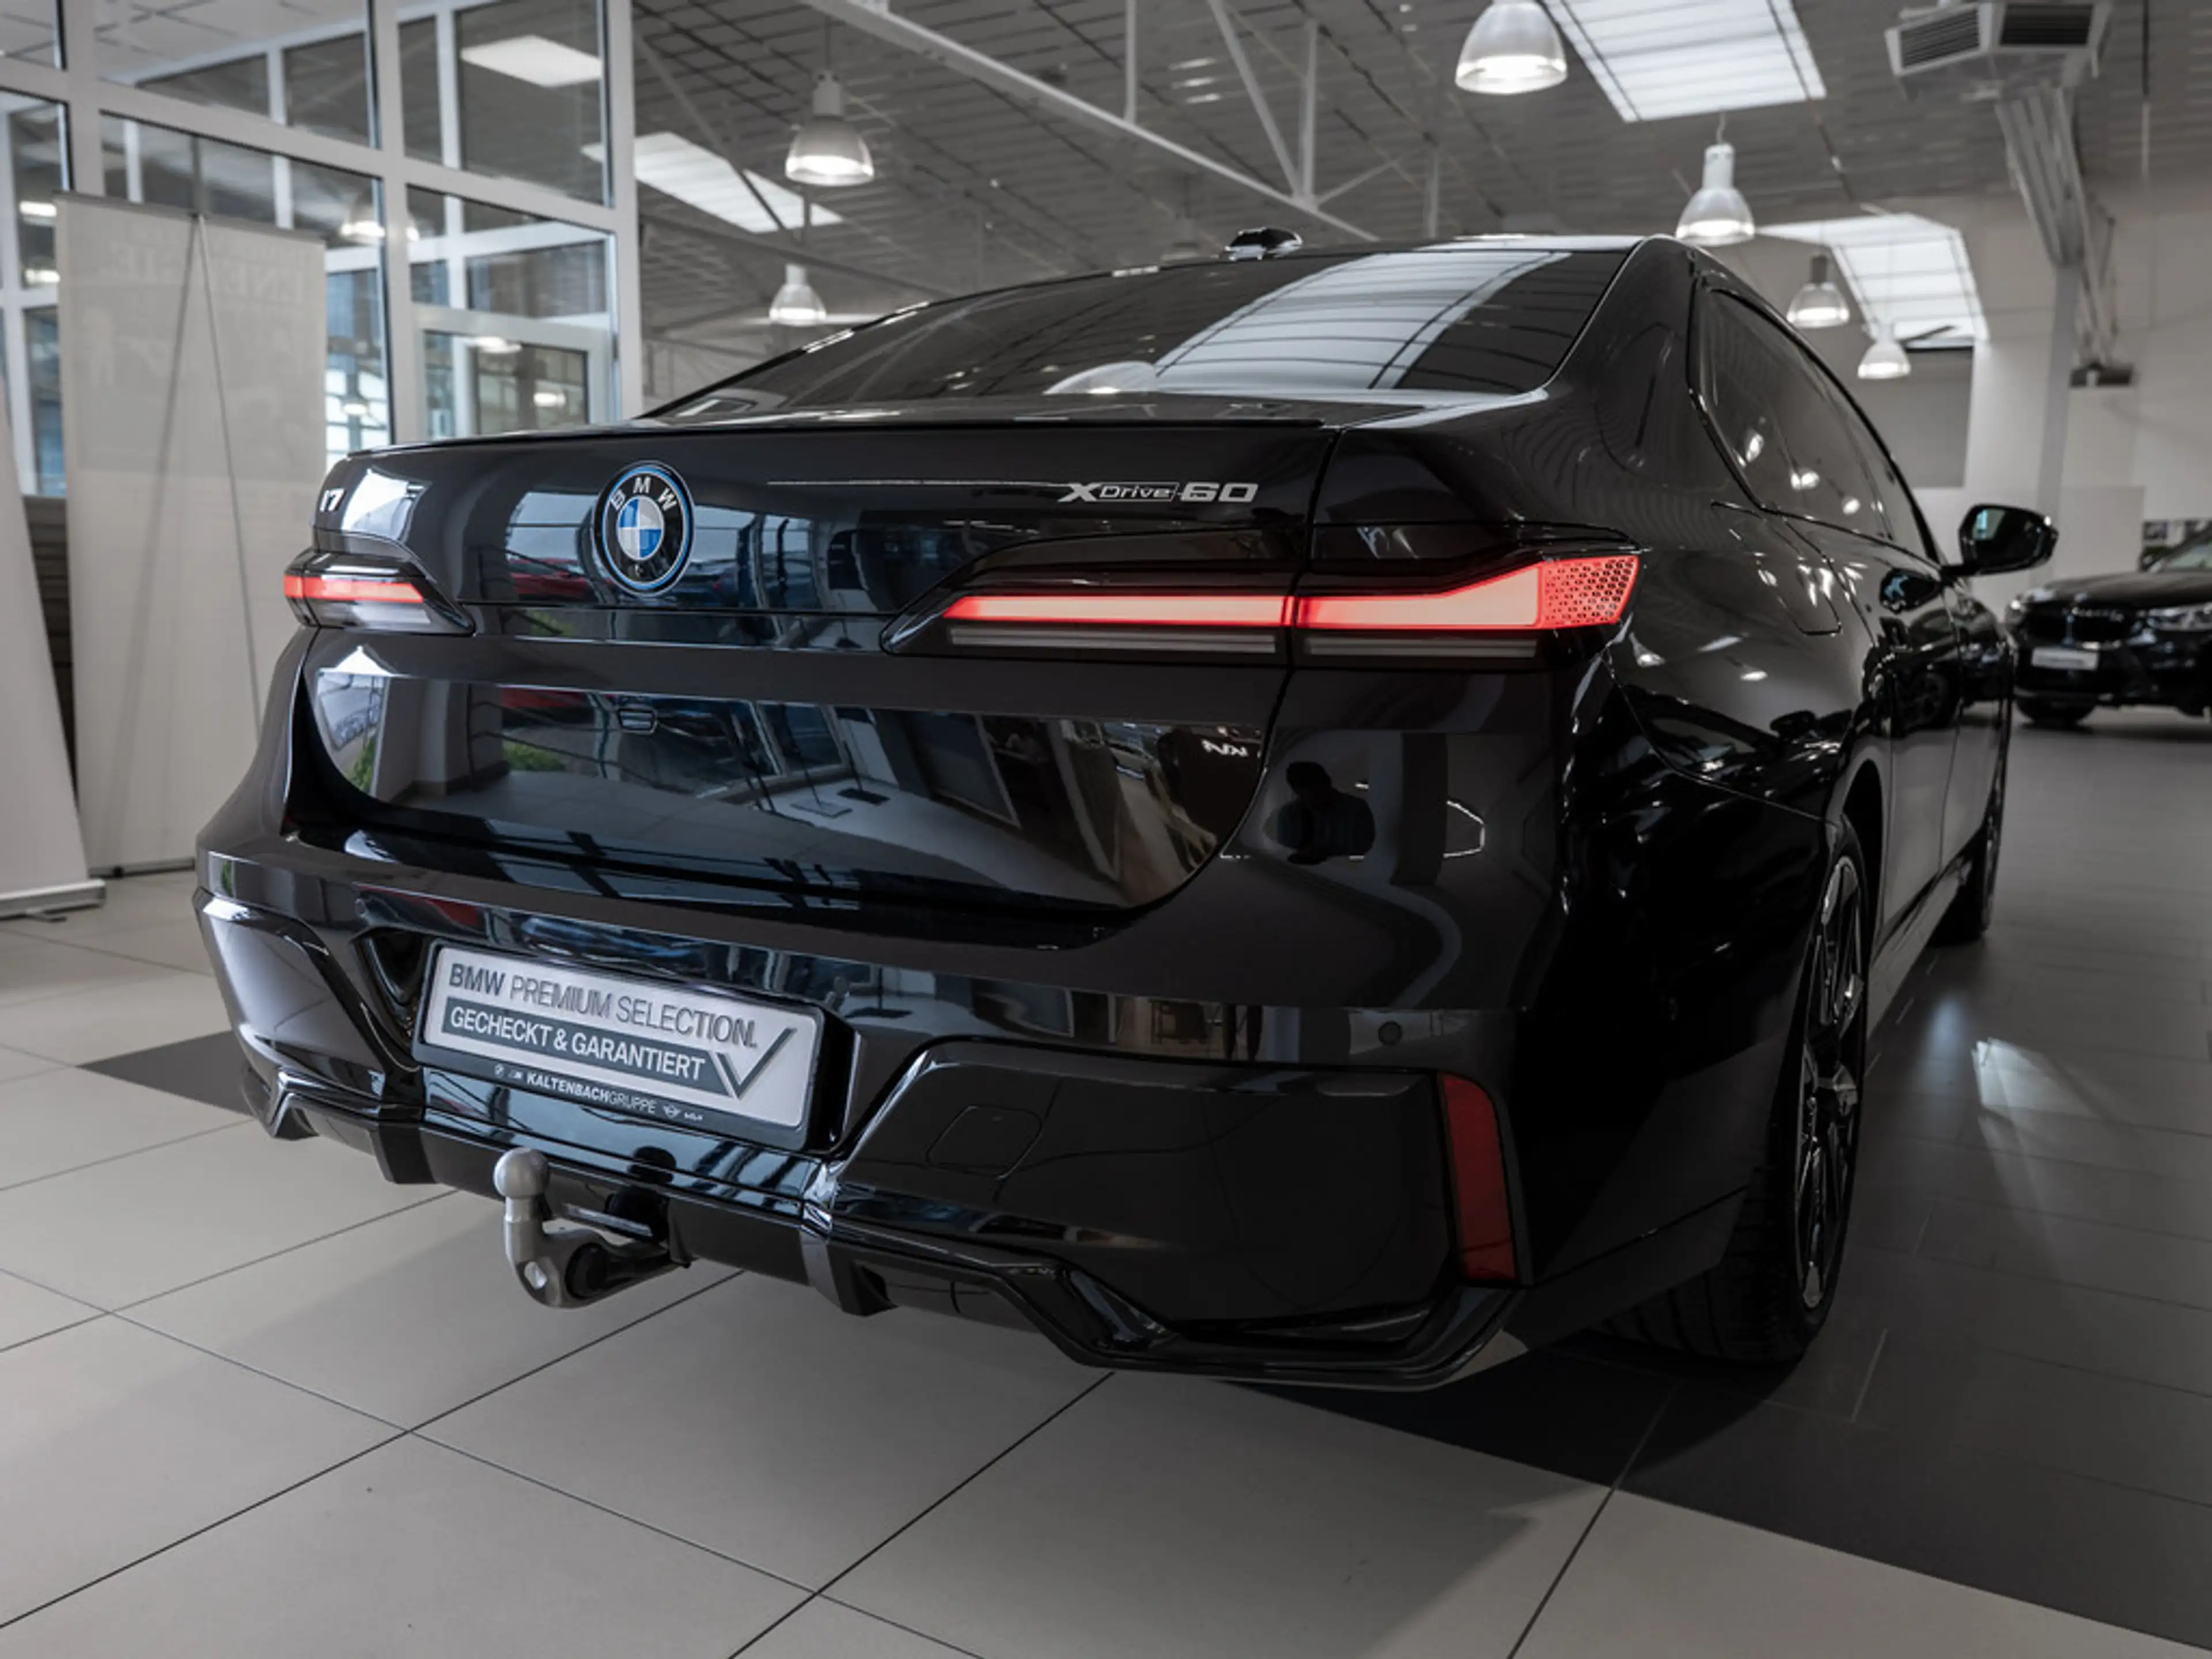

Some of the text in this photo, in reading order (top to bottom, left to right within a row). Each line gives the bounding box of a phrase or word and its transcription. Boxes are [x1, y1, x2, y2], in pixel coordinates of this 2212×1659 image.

[610, 476, 677, 512] BMW
[449, 963, 505, 996] BMW
[510, 975, 612, 1018] PREMIUM
[450, 1006, 706, 1081] GECHECKT & GARANTIERT
